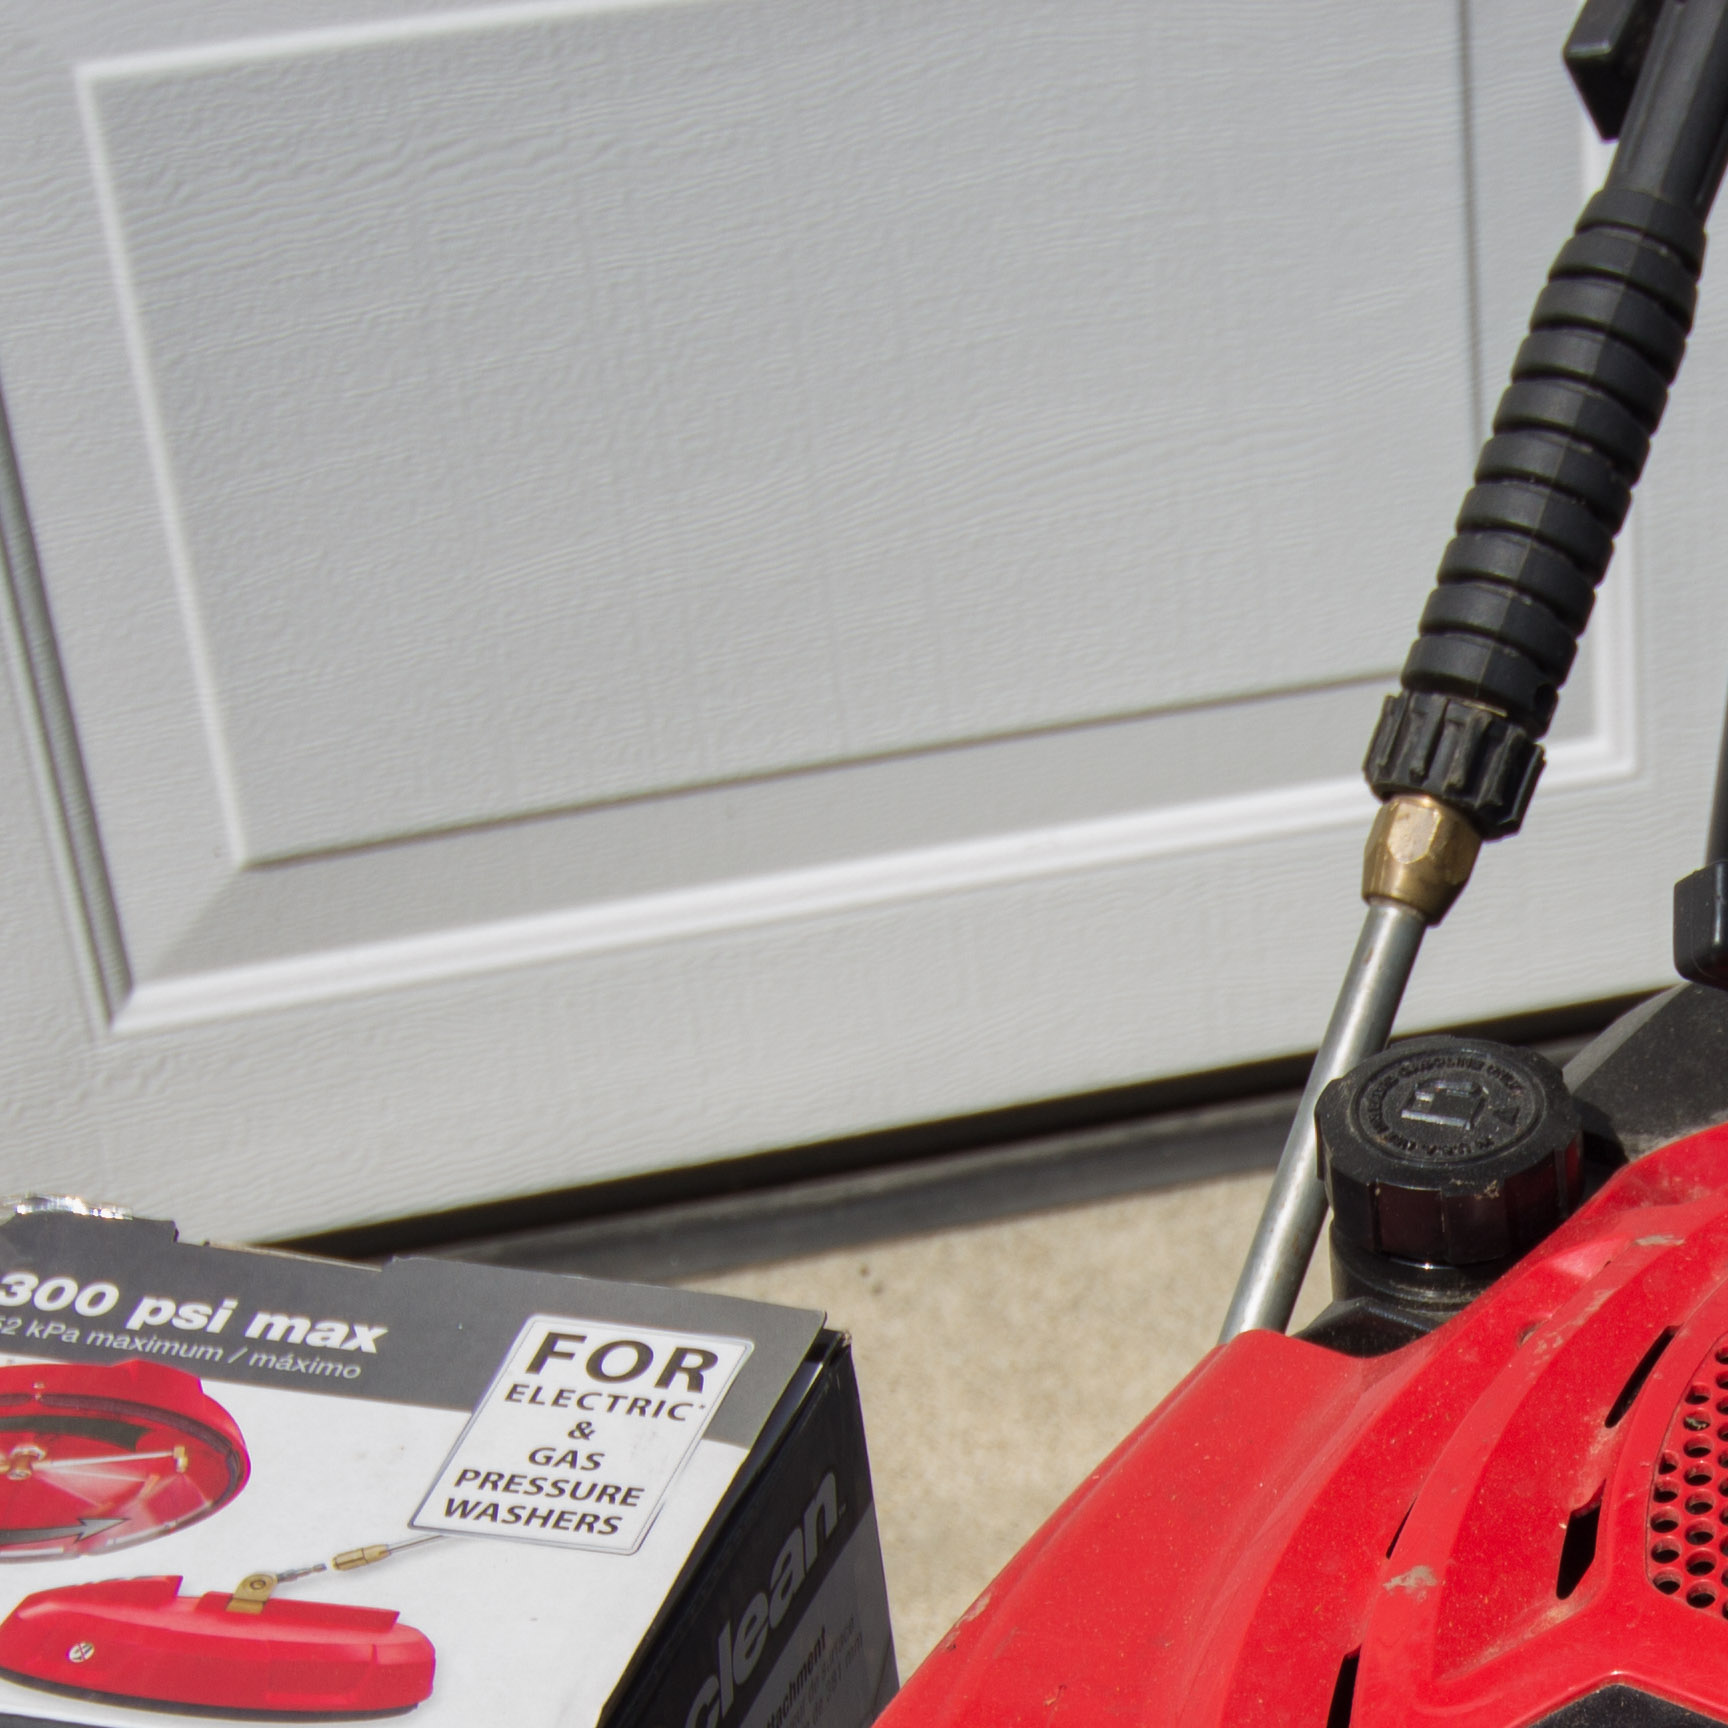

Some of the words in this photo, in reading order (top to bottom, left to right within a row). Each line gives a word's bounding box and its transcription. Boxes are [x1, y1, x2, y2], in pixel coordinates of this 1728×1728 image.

[125, 1296, 239, 1334] psi
[244, 1311, 389, 1354] max
[25, 1319, 80, 1344] kPa
[86, 1330, 223, 1363] maximum
[249, 1351, 362, 1379] máximo
[525, 1331, 719, 1394] FOR
[567, 1420, 596, 1441] &
[528, 1446, 606, 1471] GAS
[454, 1468, 646, 1507] PRESSURE
[443, 1497, 624, 1536] WASHERS
